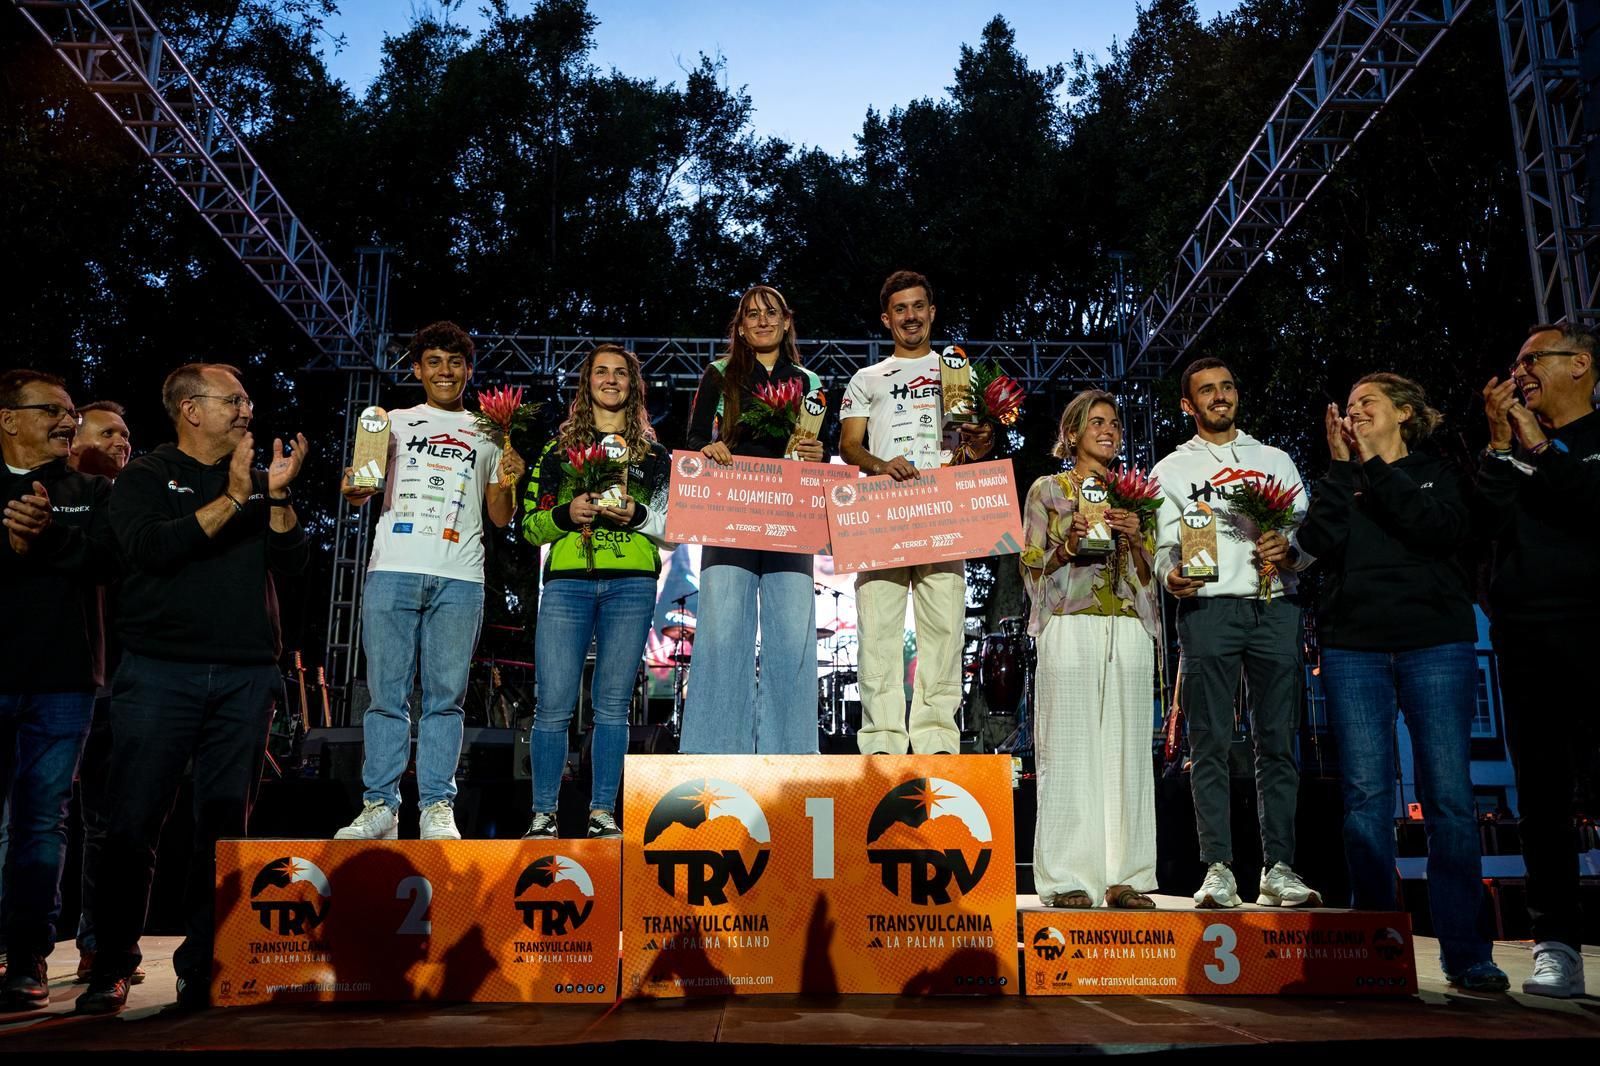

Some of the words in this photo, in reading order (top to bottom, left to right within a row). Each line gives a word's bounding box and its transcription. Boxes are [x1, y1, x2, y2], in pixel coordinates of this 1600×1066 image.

[943, 356, 967, 370] TRV
[889, 383, 942, 400] HILER
[406, 435, 477, 470] HILERA
[713, 471, 783, 484] HALFMARATHON
[800, 477, 820, 487] MEDIA
[955, 480, 976, 490] MEDIA
[978, 473, 1008, 487] MARATÓN
[678, 483, 710, 499] VUELO
[727, 488, 794, 506] ALOJAMIENTO
[868, 486, 939, 500] HALFMARATHON
[1082, 489, 1108, 503] TRV
[60, 505, 90, 513] TERREX
[836, 510, 870, 526] VUELO
[887, 500, 954, 522] ALOJAMIENTO
[971, 494, 1010, 511] DORSAL
[735, 524, 761, 533] TERREX
[901, 538, 928, 549] TERREX
[805, 797, 835, 880] 1
[643, 849, 770, 907] TRV
[867, 848, 992, 906] TRV
[395, 876, 433, 935] 2
[251, 900, 331, 936] TRV
[514, 900, 594, 936] TRV
[643, 914, 769, 933] TRANSVULCANIA
[867, 914, 993, 932] TRANSVULCANIA
[663, 937, 675, 950] LA
[683, 936, 721, 949] PALMA
[727, 935, 770, 948] ISLAND
[886, 936, 900, 949] LA
[907, 935, 944, 948] PALMA
[952, 935, 994, 948] ISLAND
[1069, 929, 1175, 945] TRANSVULCANIA
[1262, 929, 1366, 945] TRANSVULCANIA
[249, 941, 331, 954] TRANSVULCANIA
[514, 941, 593, 954] TRANSVULCANIA
[1034, 946, 1065, 961] TRV
[1087, 948, 1100, 959] LA
[1104, 948, 1135, 959] PALMA
[1141, 947, 1177, 960] ISLAND
[1203, 923, 1241, 986] 3
[1280, 948, 1291, 960] LA
[1296, 948, 1328, 960] PALMA
[1333, 947, 1369, 960] ISLAND
[261, 955, 271, 965] LA
[274, 954, 300, 964] PALMA
[303, 953, 332, 963] ISLAND
[525, 955, 535, 965] LA
[538, 955, 564, 964] PALMA
[567, 954, 593, 964] ISLAND
[674, 974, 774, 987] www.transvulcania.com
[1077, 975, 1178, 988] www.transvulcania.com
[265, 982, 372, 995] www.transvulcania.com
